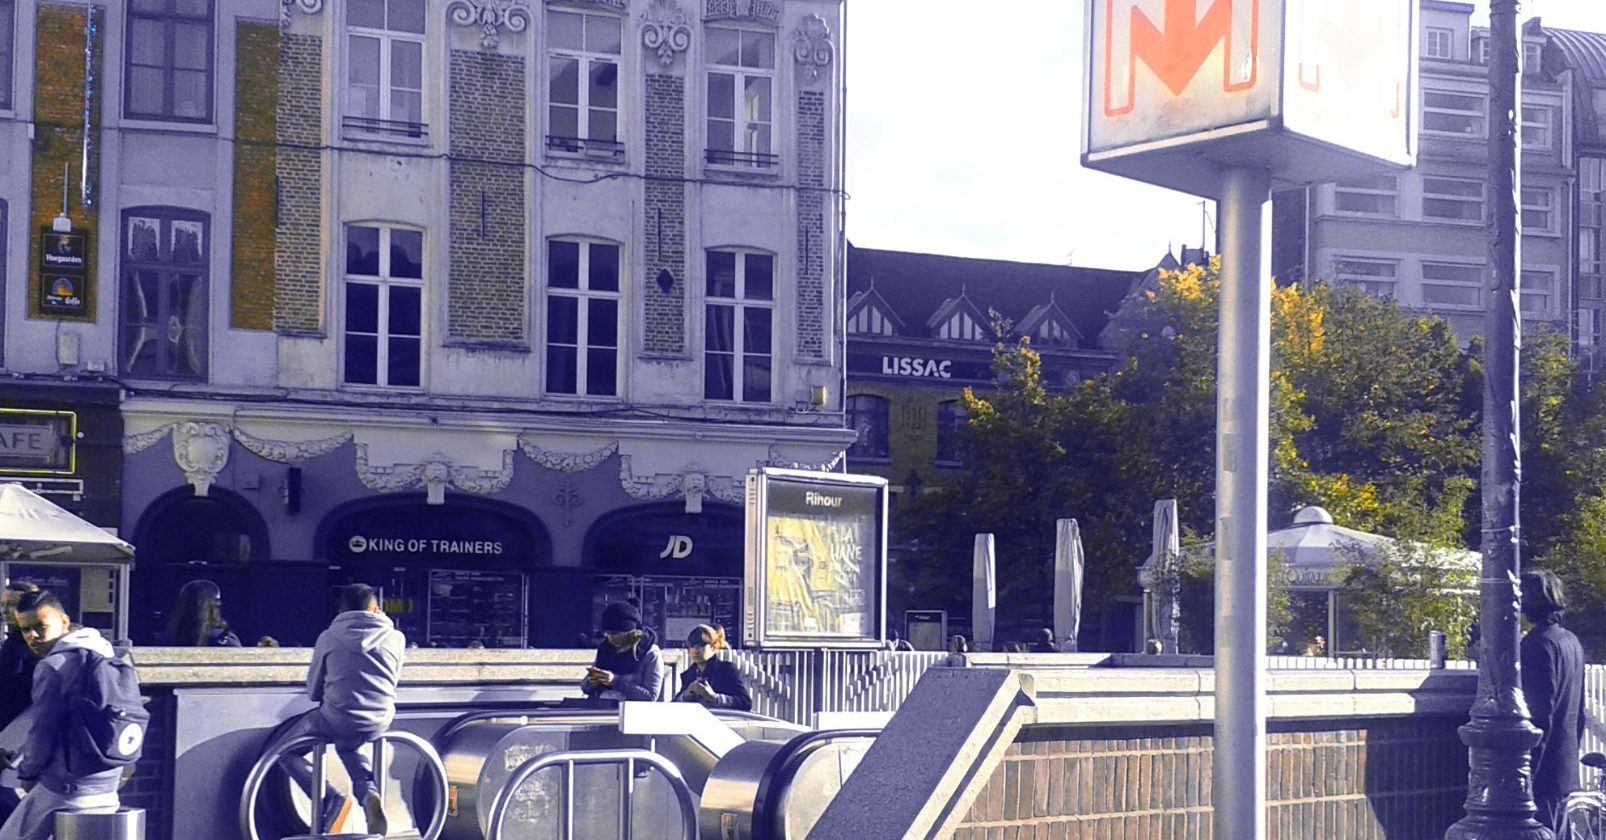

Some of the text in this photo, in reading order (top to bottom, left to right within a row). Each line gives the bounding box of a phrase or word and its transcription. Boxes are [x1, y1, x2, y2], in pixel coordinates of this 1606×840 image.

[882, 356, 952, 378] LISSAC
[805, 491, 842, 508] Rihour
[369, 538, 503, 555] KING OF TRAINERS
[660, 535, 693, 559] JD
